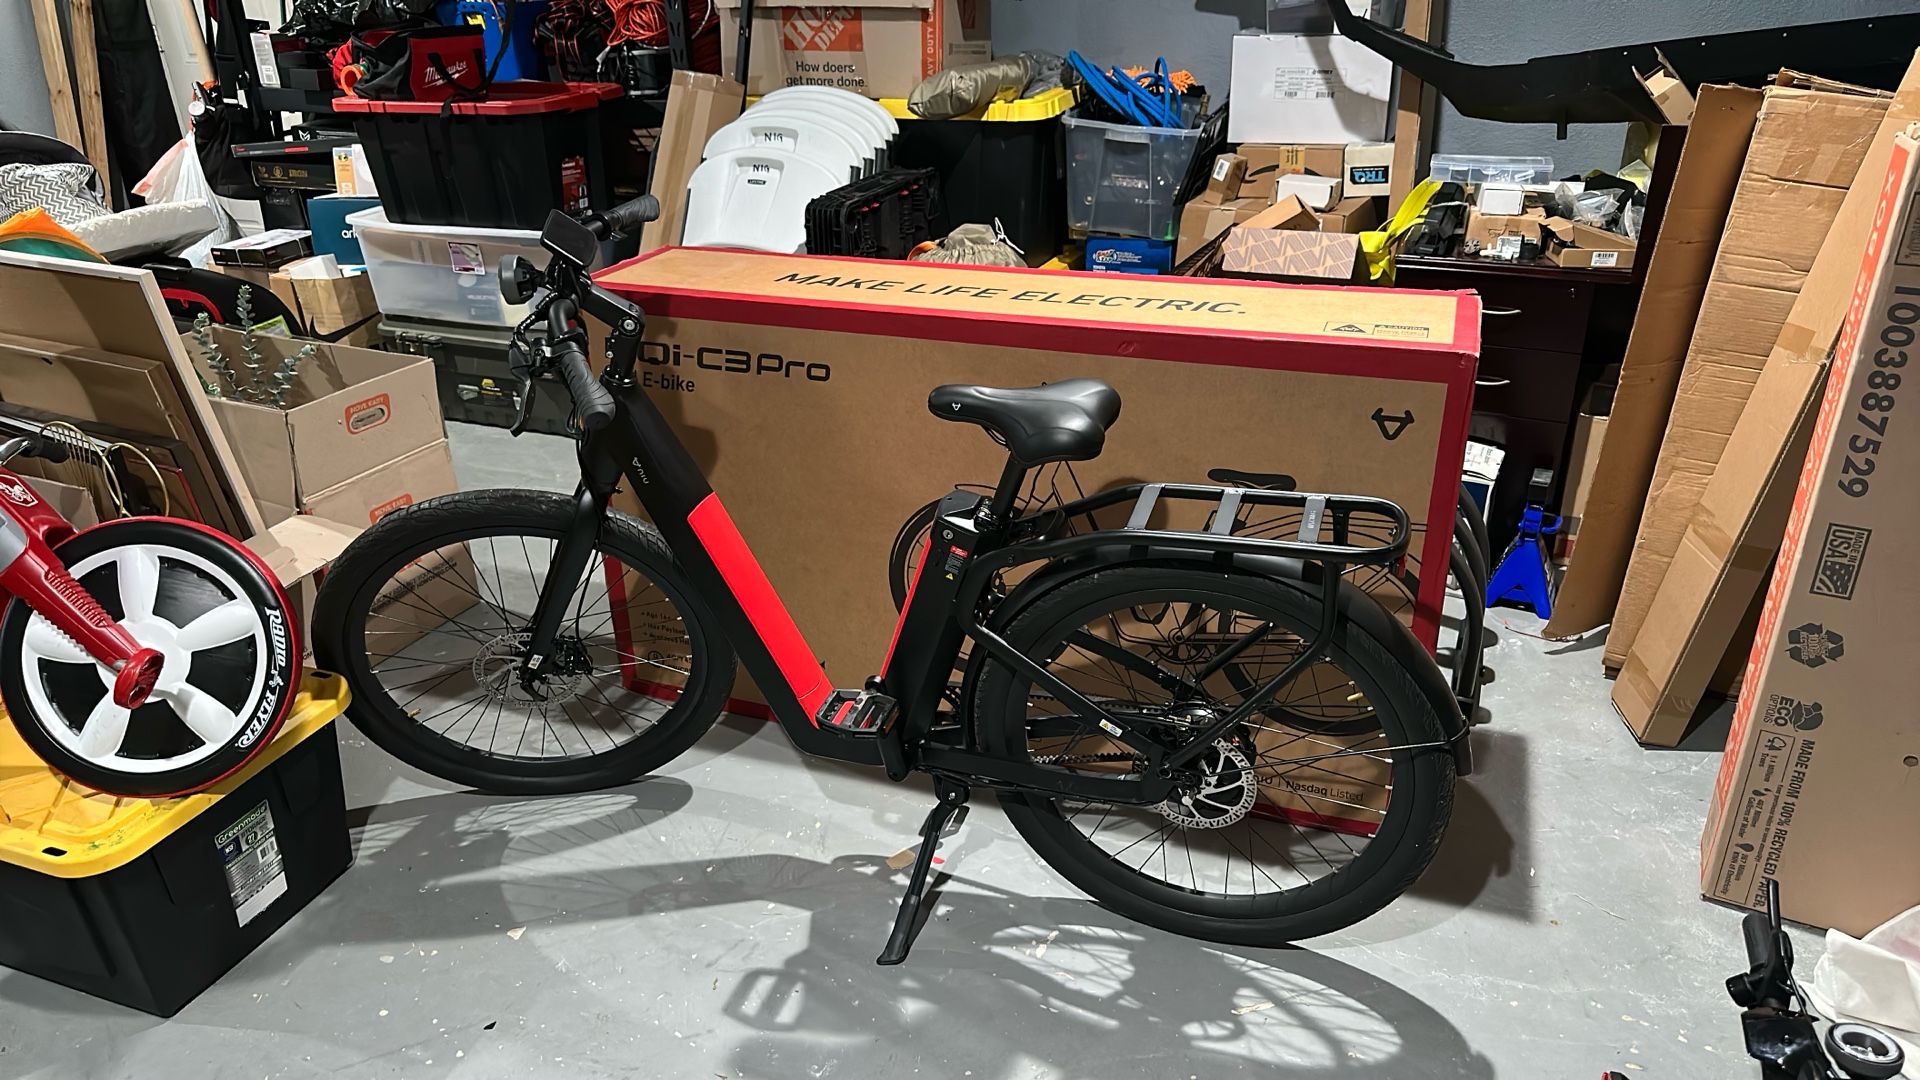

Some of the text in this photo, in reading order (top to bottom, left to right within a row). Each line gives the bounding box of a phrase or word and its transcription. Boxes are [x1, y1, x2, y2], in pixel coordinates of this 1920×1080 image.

[926, 26, 936, 53] DUTY
[796, 61, 854, 73] How doers
[786, 76, 803, 88] get
[806, 78, 834, 87] more
[1868, 171, 1896, 256] BOX
[775, 273, 1247, 314] MAKE LIFE ELECTRIC.
[643, 371, 695, 393] E-bike
[1826, 529, 1855, 558] USA
[1848, 532, 1864, 564] MADE IN
[1763, 694, 1779, 723] OPTIONS
[1774, 696, 1794, 727] ECO
[1286, 781, 1328, 797] Nasdaq
[1330, 788, 1364, 801] Listed
[216, 804, 266, 844] Greenmade
[1751, 738, 1815, 910] MADE FROM 100% RECYCLED PAPER.
